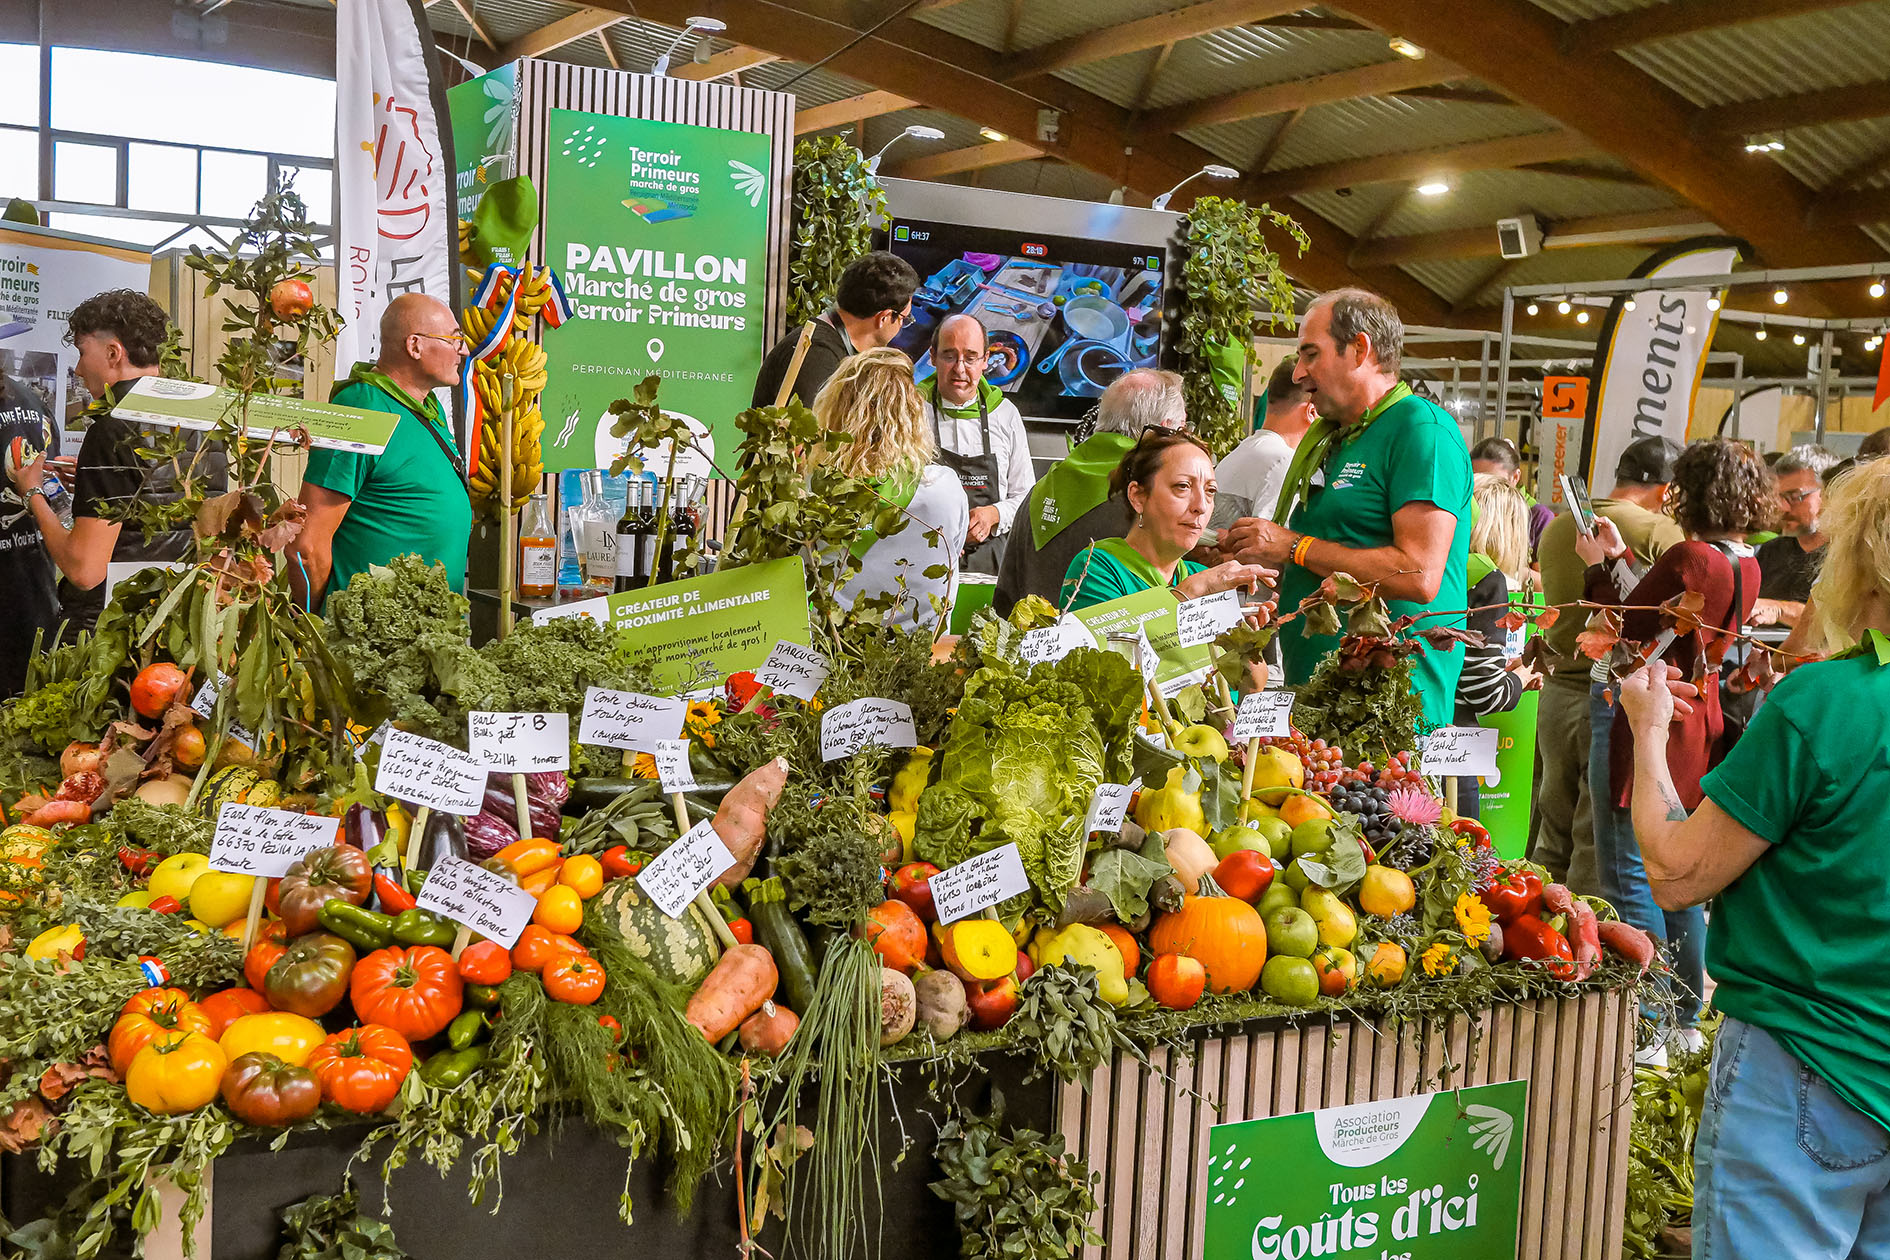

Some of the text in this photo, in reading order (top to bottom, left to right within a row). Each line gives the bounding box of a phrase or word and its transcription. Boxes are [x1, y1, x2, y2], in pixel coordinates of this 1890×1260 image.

[629, 146, 682, 166] Terroir
[631, 163, 700, 184] Primeurs
[630, 180, 700, 194] marché de gros
[911, 231, 930, 241] 6H:37
[0, 255, 26, 274] roir
[566, 242, 747, 285] PAVILLON
[12, 292, 22, 303] de
[24, 295, 40, 306] gros
[564, 272, 747, 312] Marché de gros
[567, 298, 746, 331] Terroir Primeurs
[572, 364, 734, 382] PERPIGNAN MÉDITERRANÉE
[15, 406, 40, 423] FLIES
[286, 405, 365, 420] ALIMENTAIRE
[615, 590, 700, 617] CRÉATEUR DE
[616, 589, 770, 631] PROXIMITÉ ALIMENTAIRE
[1119, 607, 1130, 617] DE
[634, 634, 708, 659] m'approvisionne
[711, 620, 762, 641] localement
[665, 649, 685, 660] mon
[727, 637, 738, 651] de
[741, 635, 760, 652] gros
[217, 833, 256, 852] 66370
[1334, 1110, 1401, 1129] Association
[1337, 1121, 1399, 1139] Producteurs
[1366, 1134, 1378, 1144] de
[1379, 1131, 1399, 1141] Gros
[1329, 1175, 1408, 1205] Tous les
[1251, 1176, 1479, 1260] Goûts d'ici
